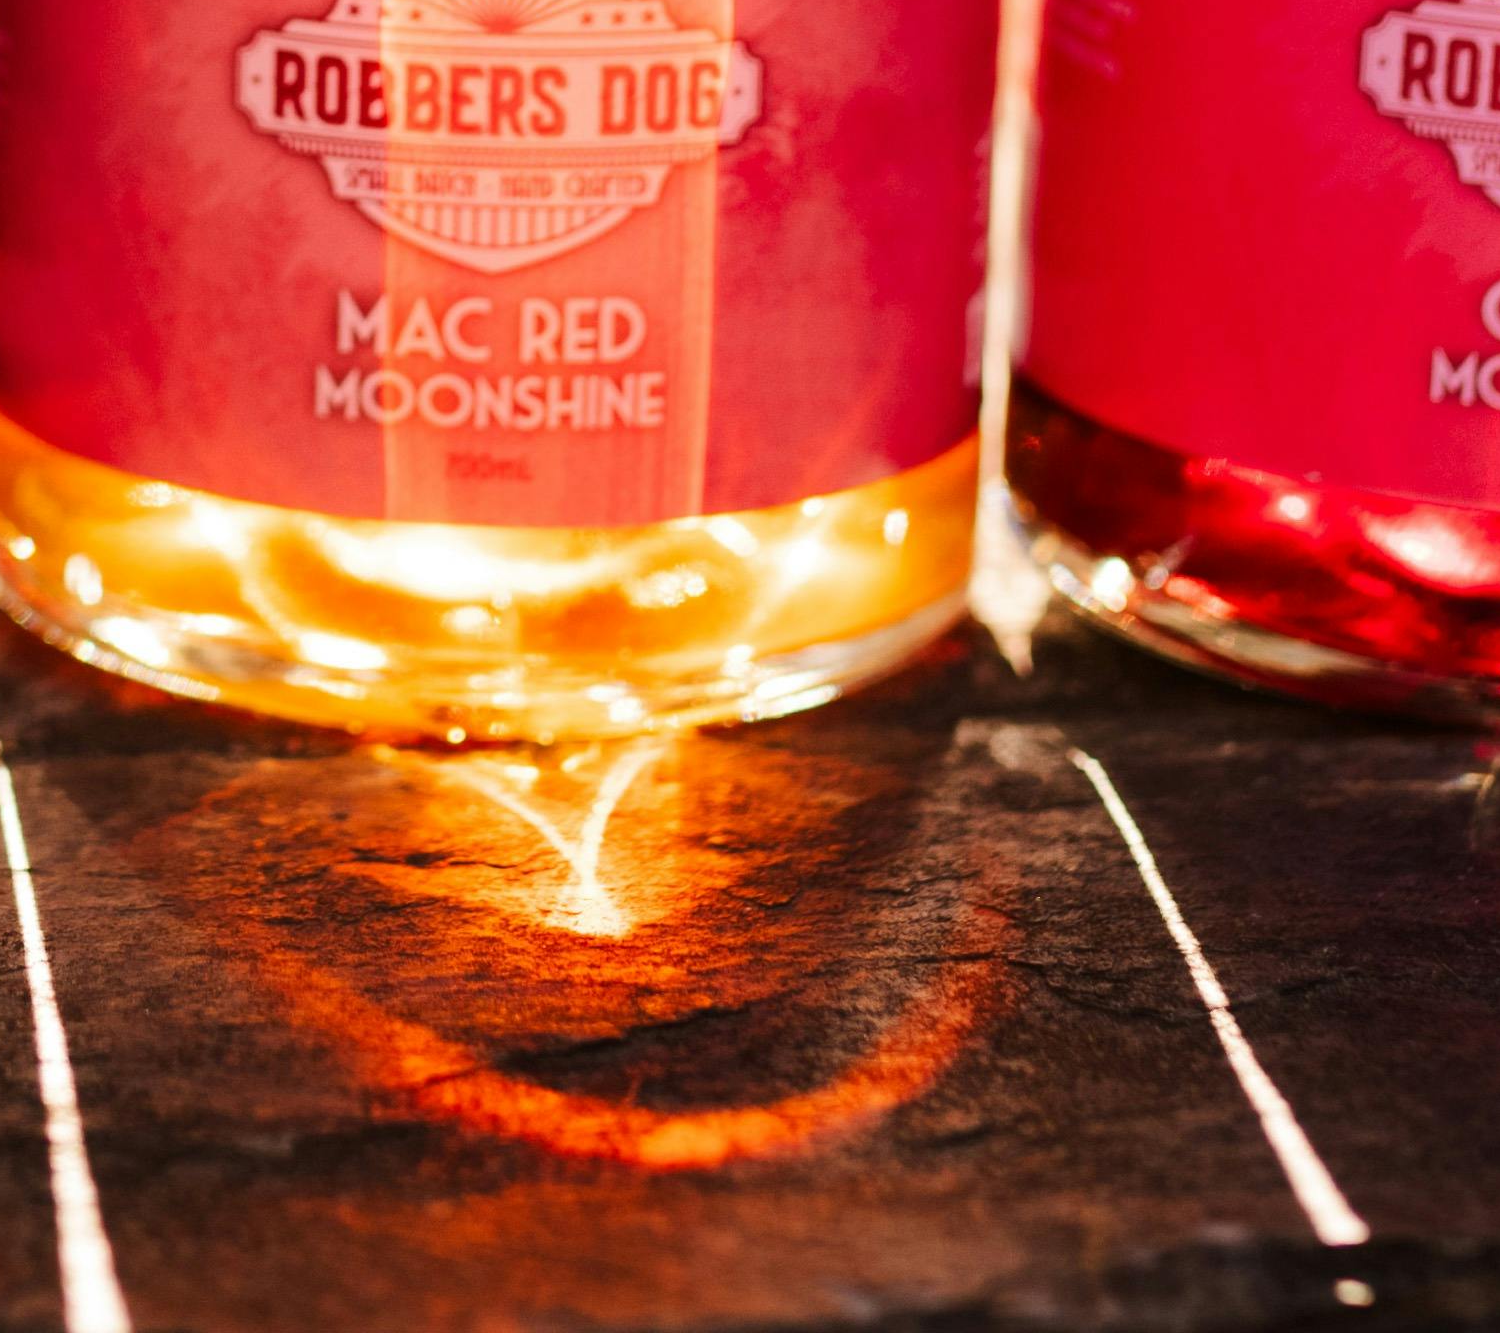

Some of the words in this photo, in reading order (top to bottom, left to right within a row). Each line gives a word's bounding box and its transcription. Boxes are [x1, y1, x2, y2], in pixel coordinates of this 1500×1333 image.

[273, 49, 569, 137] ROBBERS
[600, 60, 722, 135] DOG
[336, 287, 492, 362] MAC
[519, 295, 646, 365] RED
[313, 363, 666, 431] MOONSHINE
